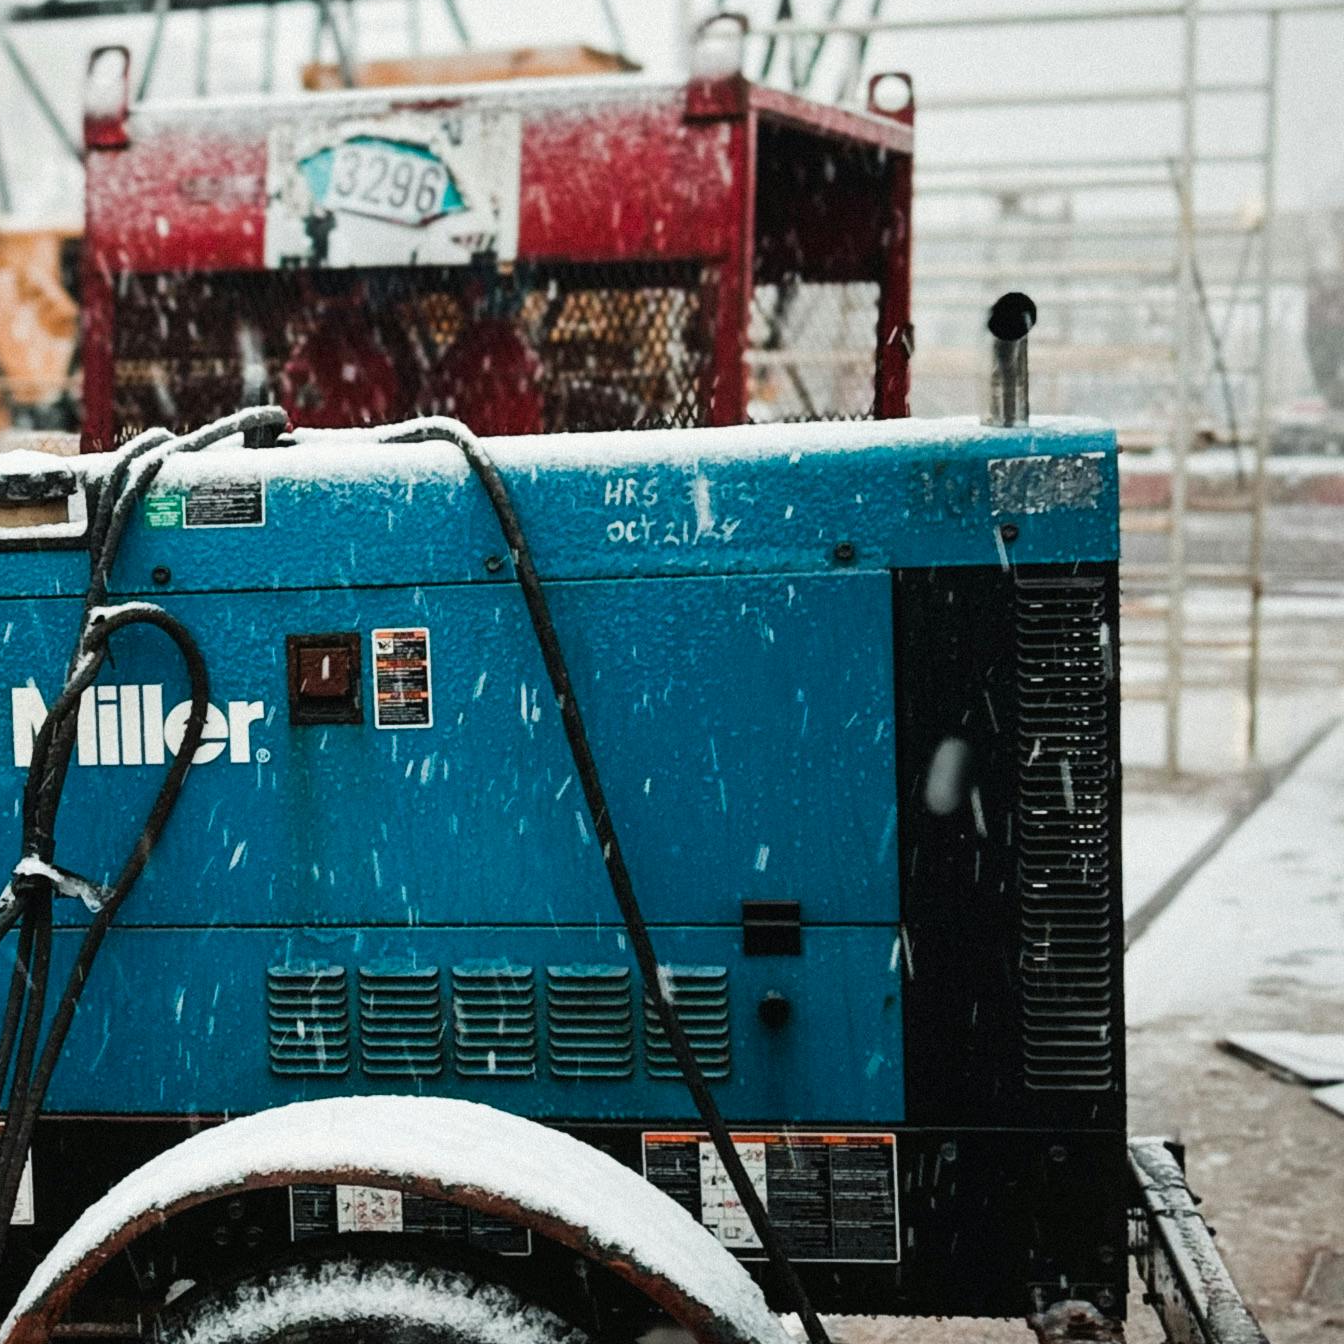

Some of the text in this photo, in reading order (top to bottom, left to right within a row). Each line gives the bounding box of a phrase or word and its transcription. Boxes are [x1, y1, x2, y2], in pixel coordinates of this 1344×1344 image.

[334, 152, 442, 213] 3296
[604, 477, 659, 507] HRS
[11, 684, 264, 767] Miller
